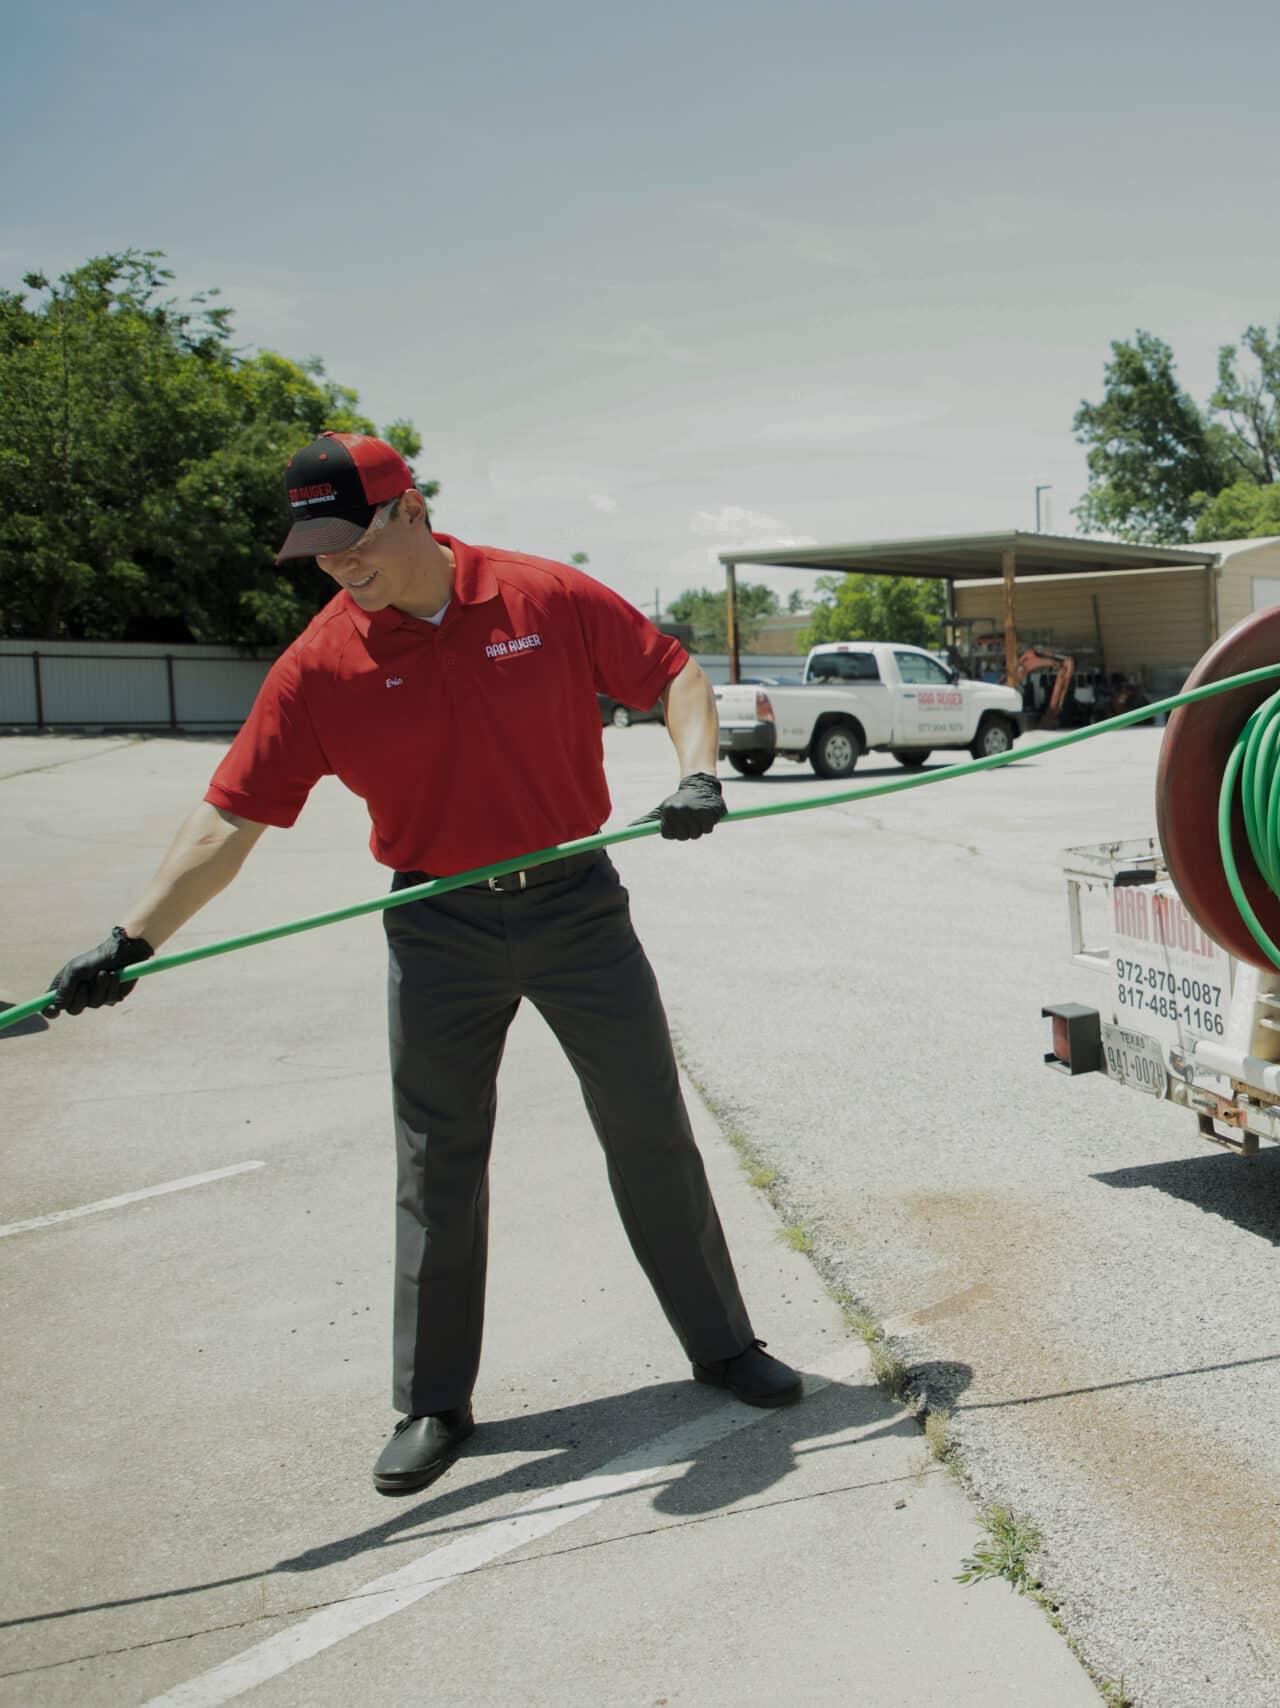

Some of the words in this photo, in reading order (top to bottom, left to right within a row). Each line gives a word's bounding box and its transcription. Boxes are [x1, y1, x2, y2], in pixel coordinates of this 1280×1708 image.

[485, 642, 507, 658] AAA
[508, 634, 541, 653] AUGER
[1113, 886, 1148, 941] AAA
[1116, 958, 1221, 1007] 972-870-0087
[1118, 984, 1224, 1035] 817-485-1166
[1120, 1031, 1145, 1049] TEXAS
